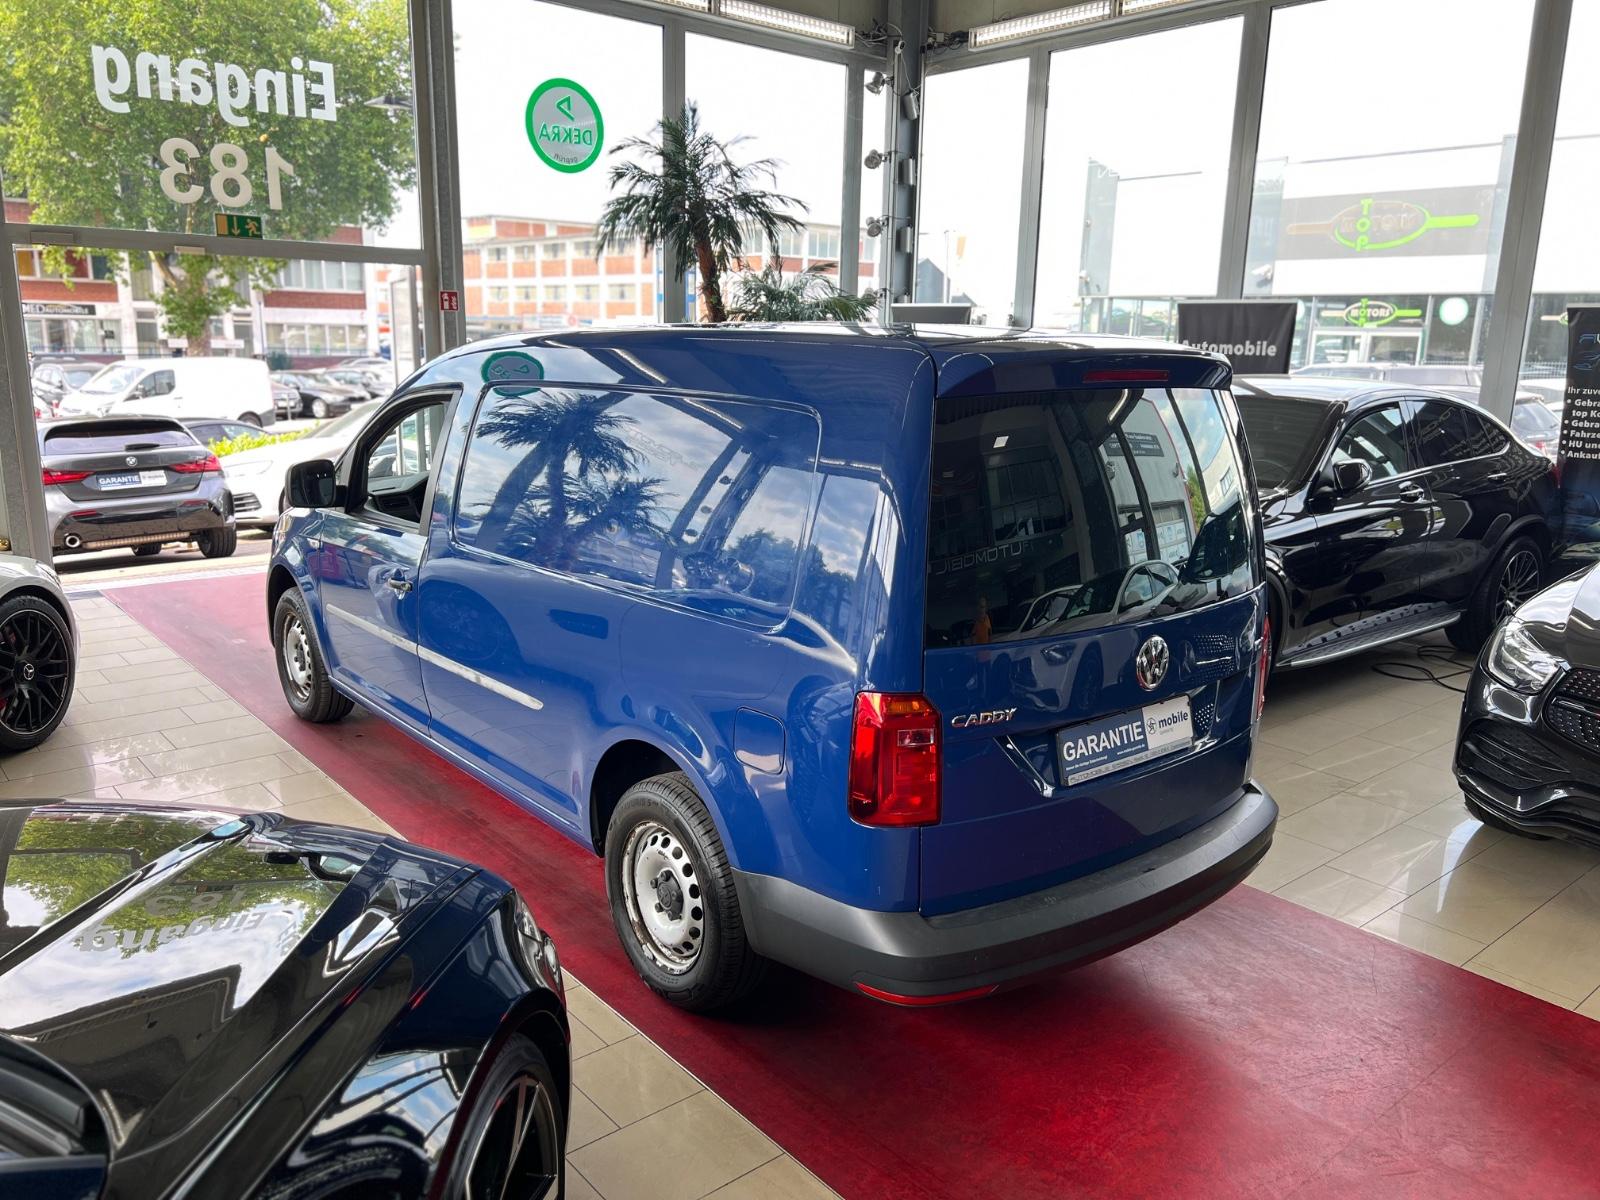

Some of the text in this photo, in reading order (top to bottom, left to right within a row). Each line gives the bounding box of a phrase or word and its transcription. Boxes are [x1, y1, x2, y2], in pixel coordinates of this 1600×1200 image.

[1567, 386, 1580, 394] Ihr
[1571, 410, 1588, 418] top
[1568, 440, 1583, 448] HU
[99, 475, 140, 485] GARANTIE
[951, 707, 1017, 727] CADDY
[1158, 711, 1189, 729] mobile
[1063, 721, 1144, 761] GARANTIE
